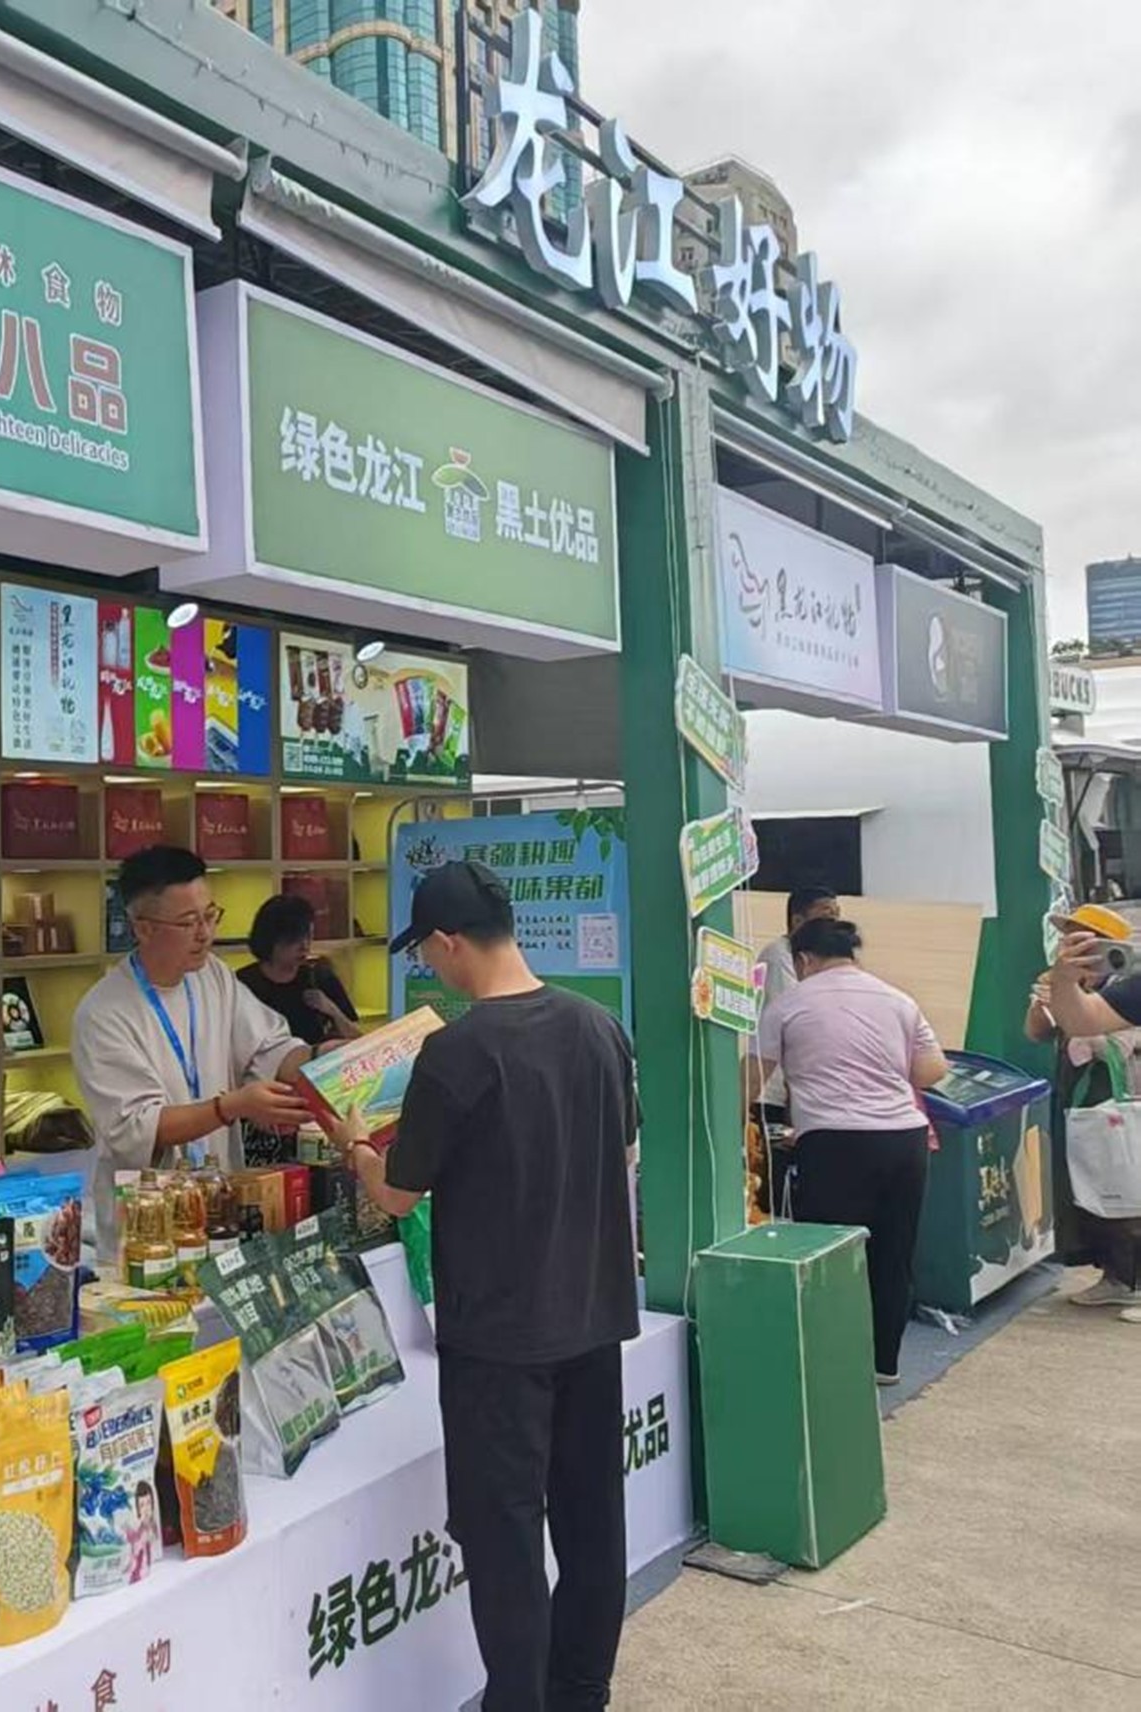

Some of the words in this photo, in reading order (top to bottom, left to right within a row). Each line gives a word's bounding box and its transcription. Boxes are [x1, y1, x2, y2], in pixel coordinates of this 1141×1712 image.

[464, 8, 858, 443] 龙江好物
[48, 423, 129, 471] Delicacies
[279, 405, 427, 514] 绿色龙江
[495, 479, 599, 564] 黑土优品
[1048, 671, 1090, 705] BUCKS
